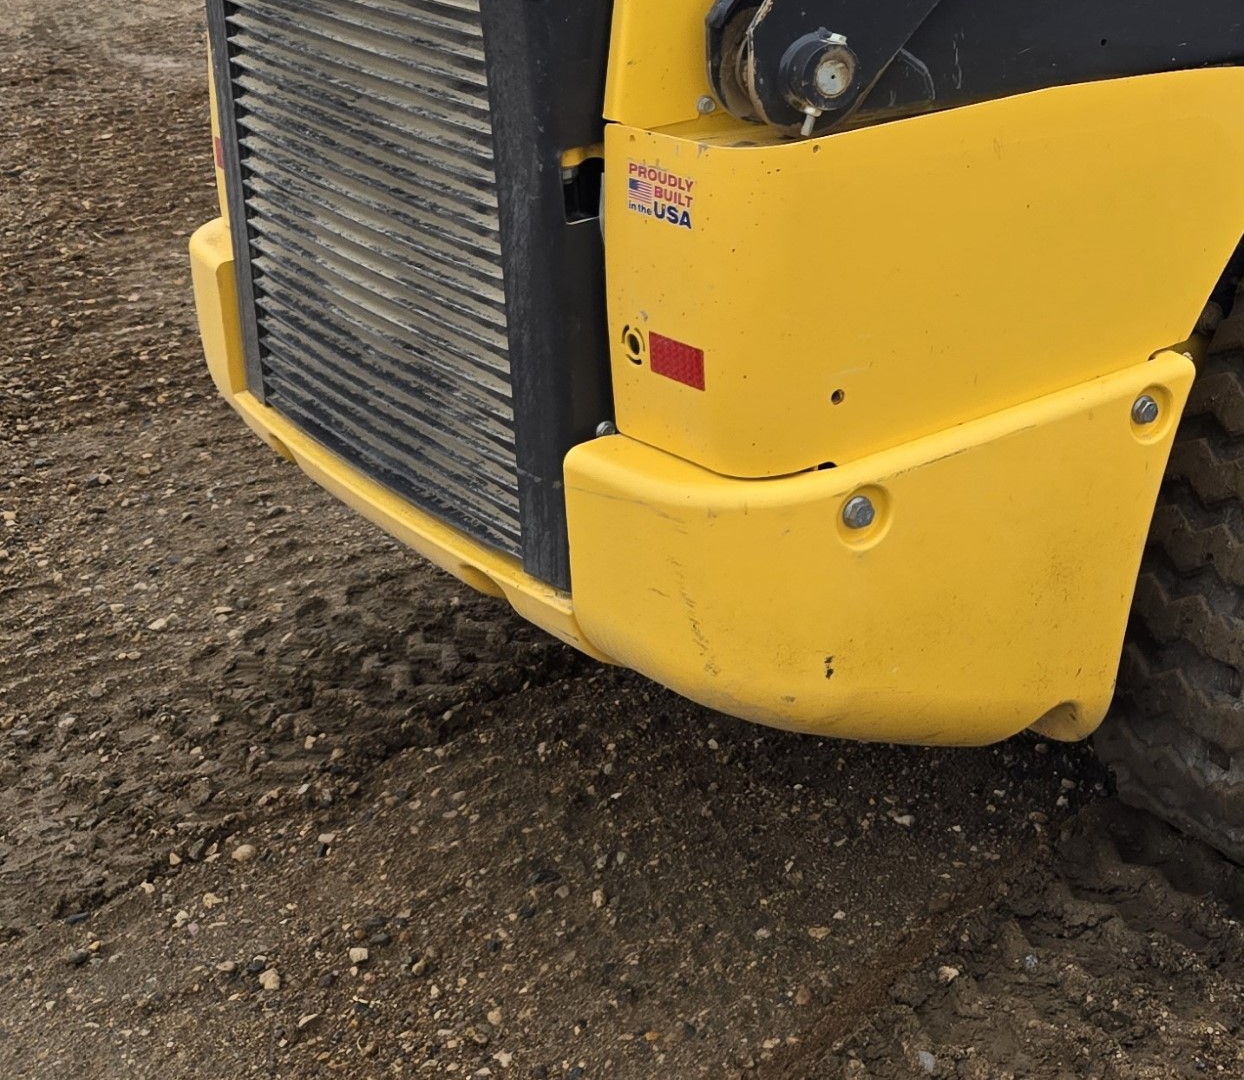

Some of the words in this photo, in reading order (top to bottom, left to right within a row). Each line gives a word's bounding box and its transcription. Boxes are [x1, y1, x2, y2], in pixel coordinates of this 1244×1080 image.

[628, 162, 694, 193] PROUDLY
[654, 185, 694, 209] BUILT
[628, 200, 637, 211] in
[637, 203, 653, 216] the
[653, 200, 693, 230] USA
